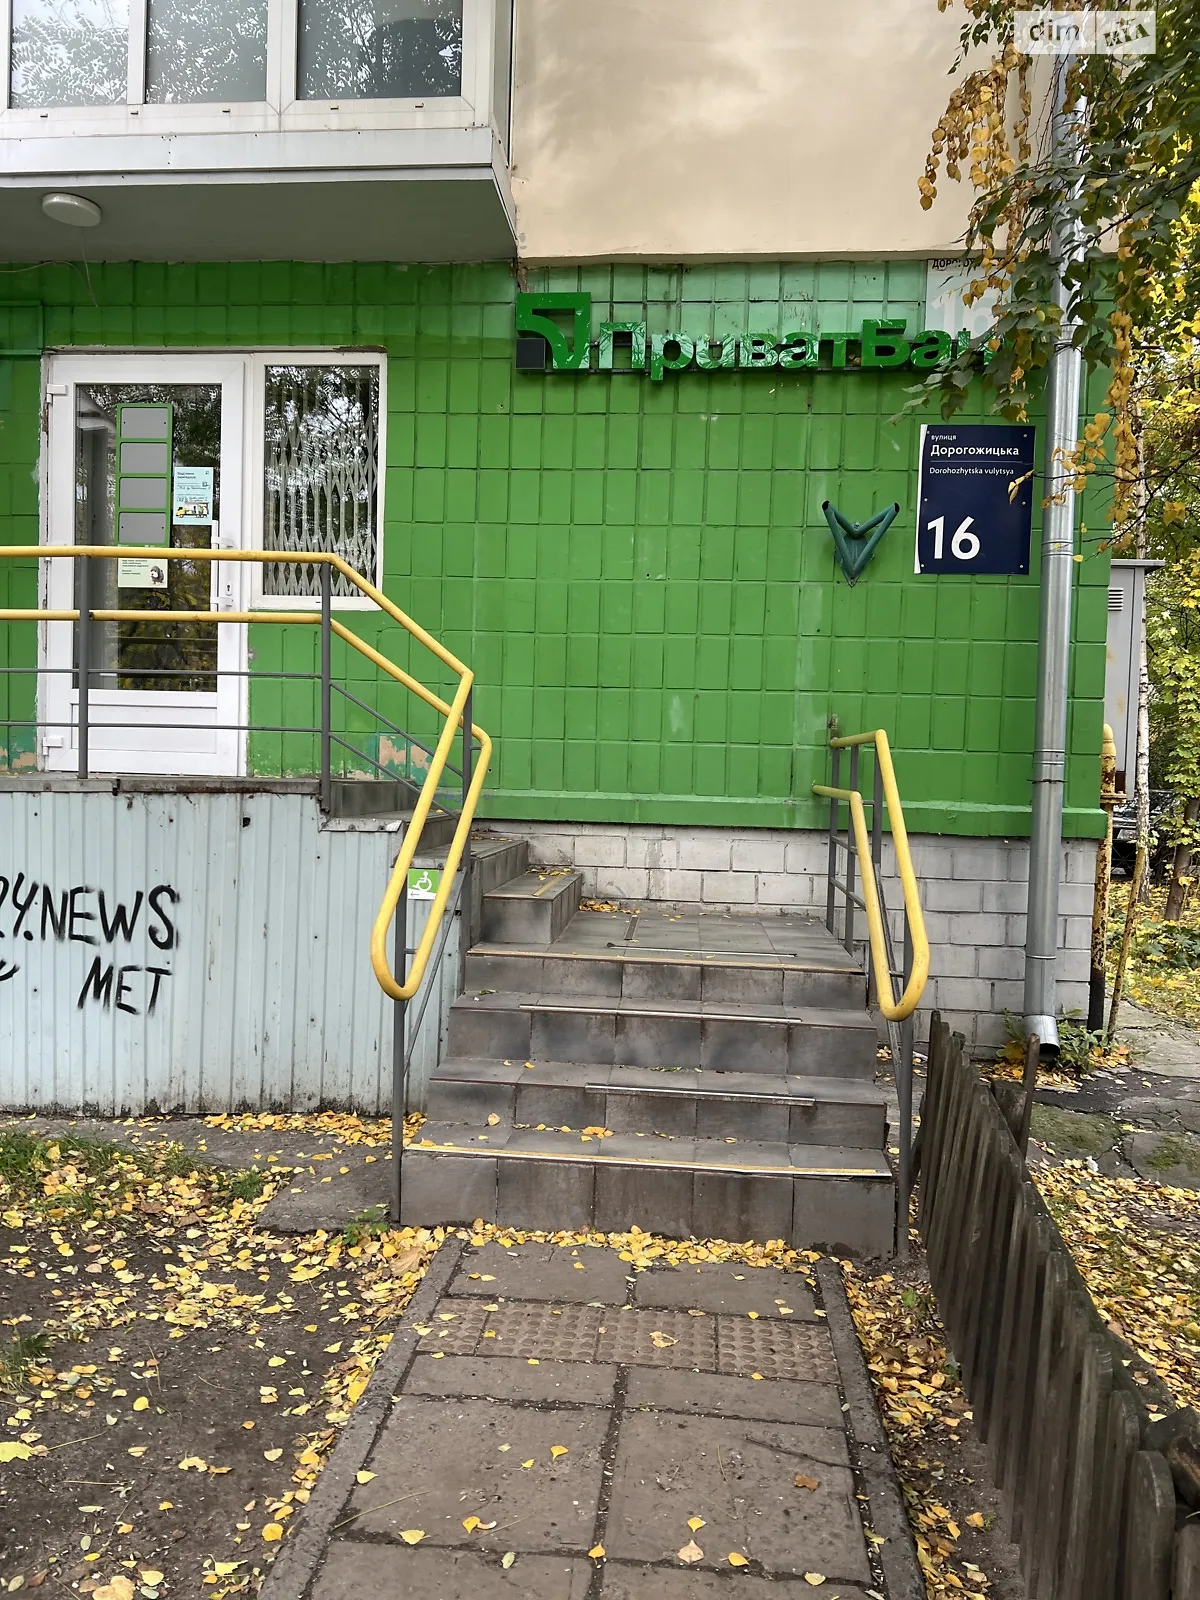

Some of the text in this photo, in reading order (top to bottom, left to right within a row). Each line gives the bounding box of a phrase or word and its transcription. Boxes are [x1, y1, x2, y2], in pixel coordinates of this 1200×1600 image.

[598, 318, 1014, 381] ПриватБан
[930, 444, 1020, 458] Дорогожицька
[929, 467, 1015, 476] Dorohozhytska vulytsya
[927, 515, 981, 560] 16
